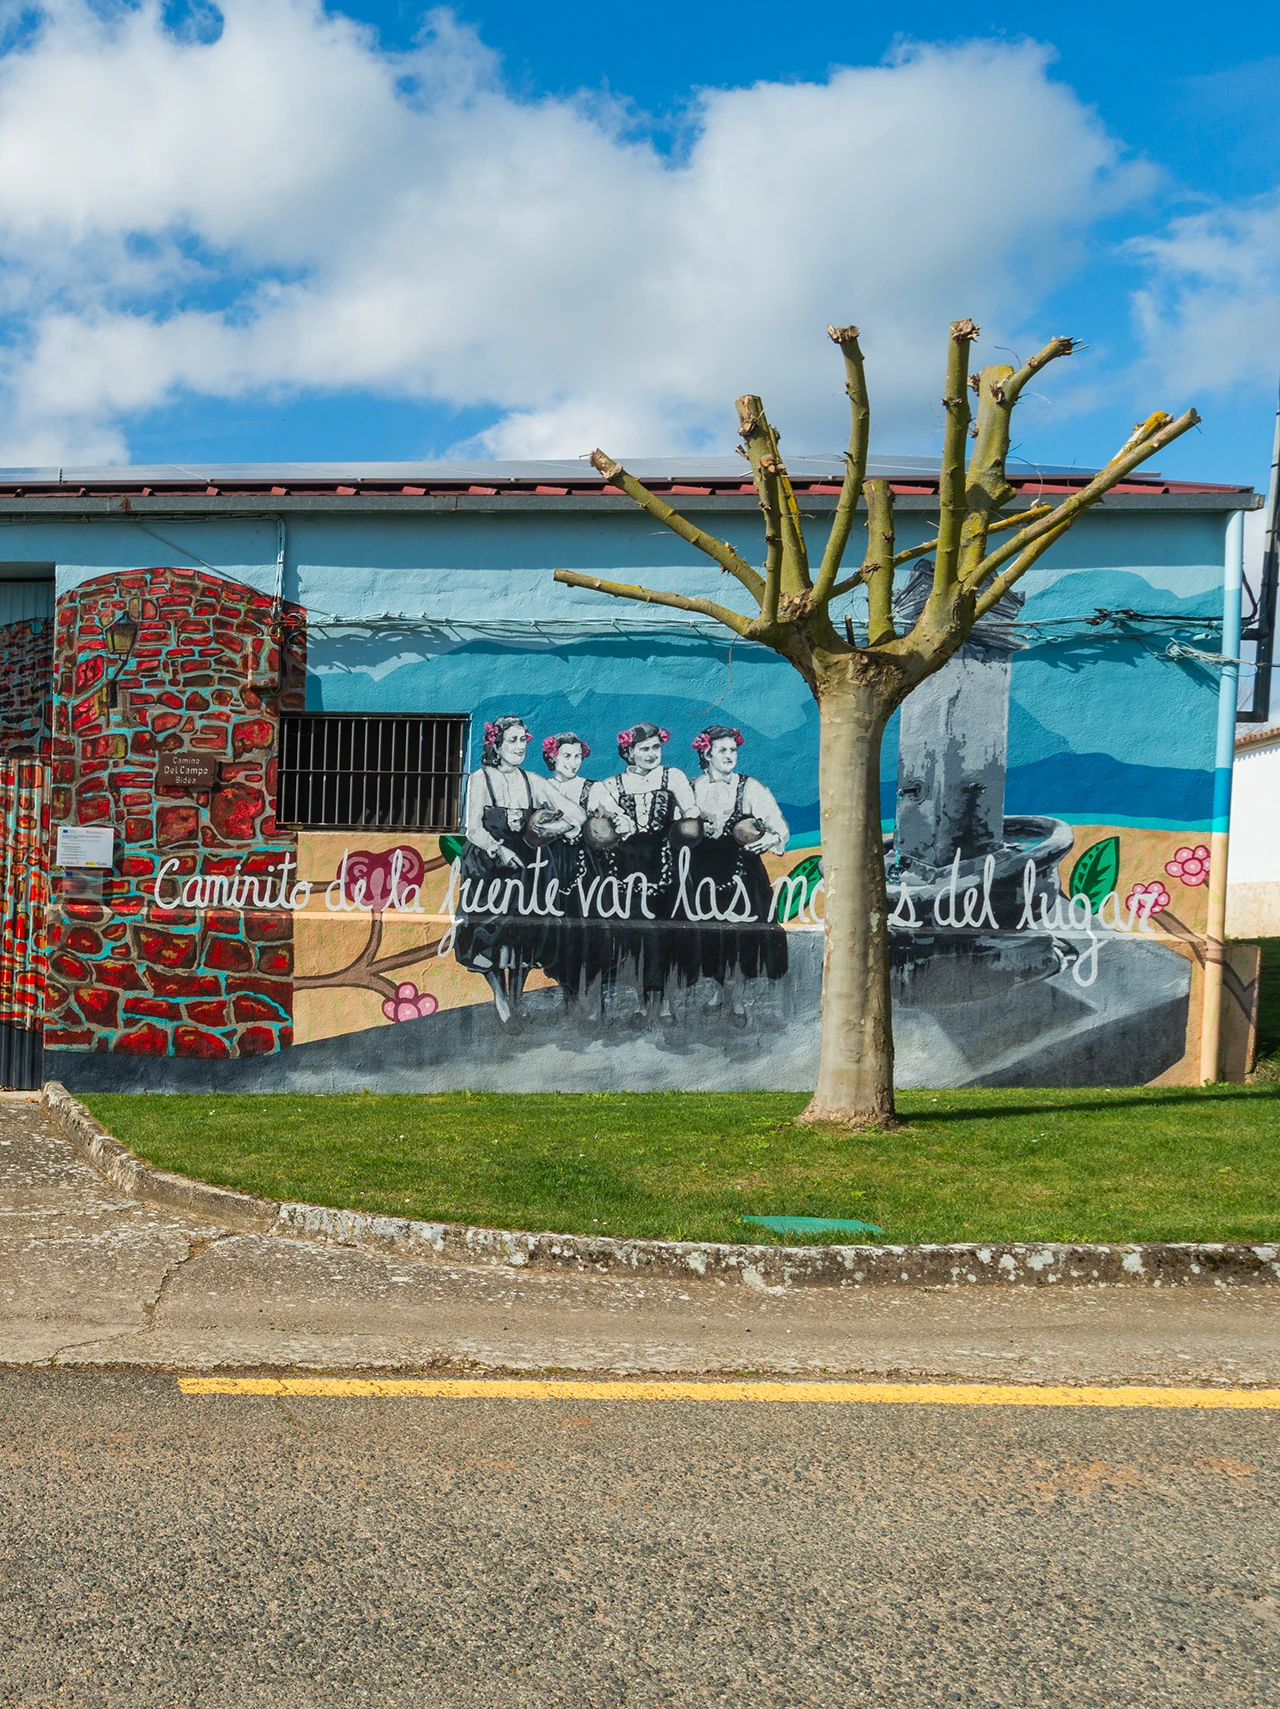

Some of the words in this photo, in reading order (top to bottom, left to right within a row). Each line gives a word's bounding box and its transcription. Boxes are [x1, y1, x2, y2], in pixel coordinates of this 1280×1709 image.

[172, 756, 200, 765] Camino
[164, 765, 178, 774] Del
[180, 765, 209, 776] Campo
[153, 851, 314, 910] Caminito
[326, 847, 376, 912] de
[380, 848, 425, 912] la
[437, 846, 565, 957] fuente
[578, 871, 656, 919] van
[671, 846, 759, 922] las
[934, 847, 1000, 930] del
[1016, 858, 1160, 987] lugar
